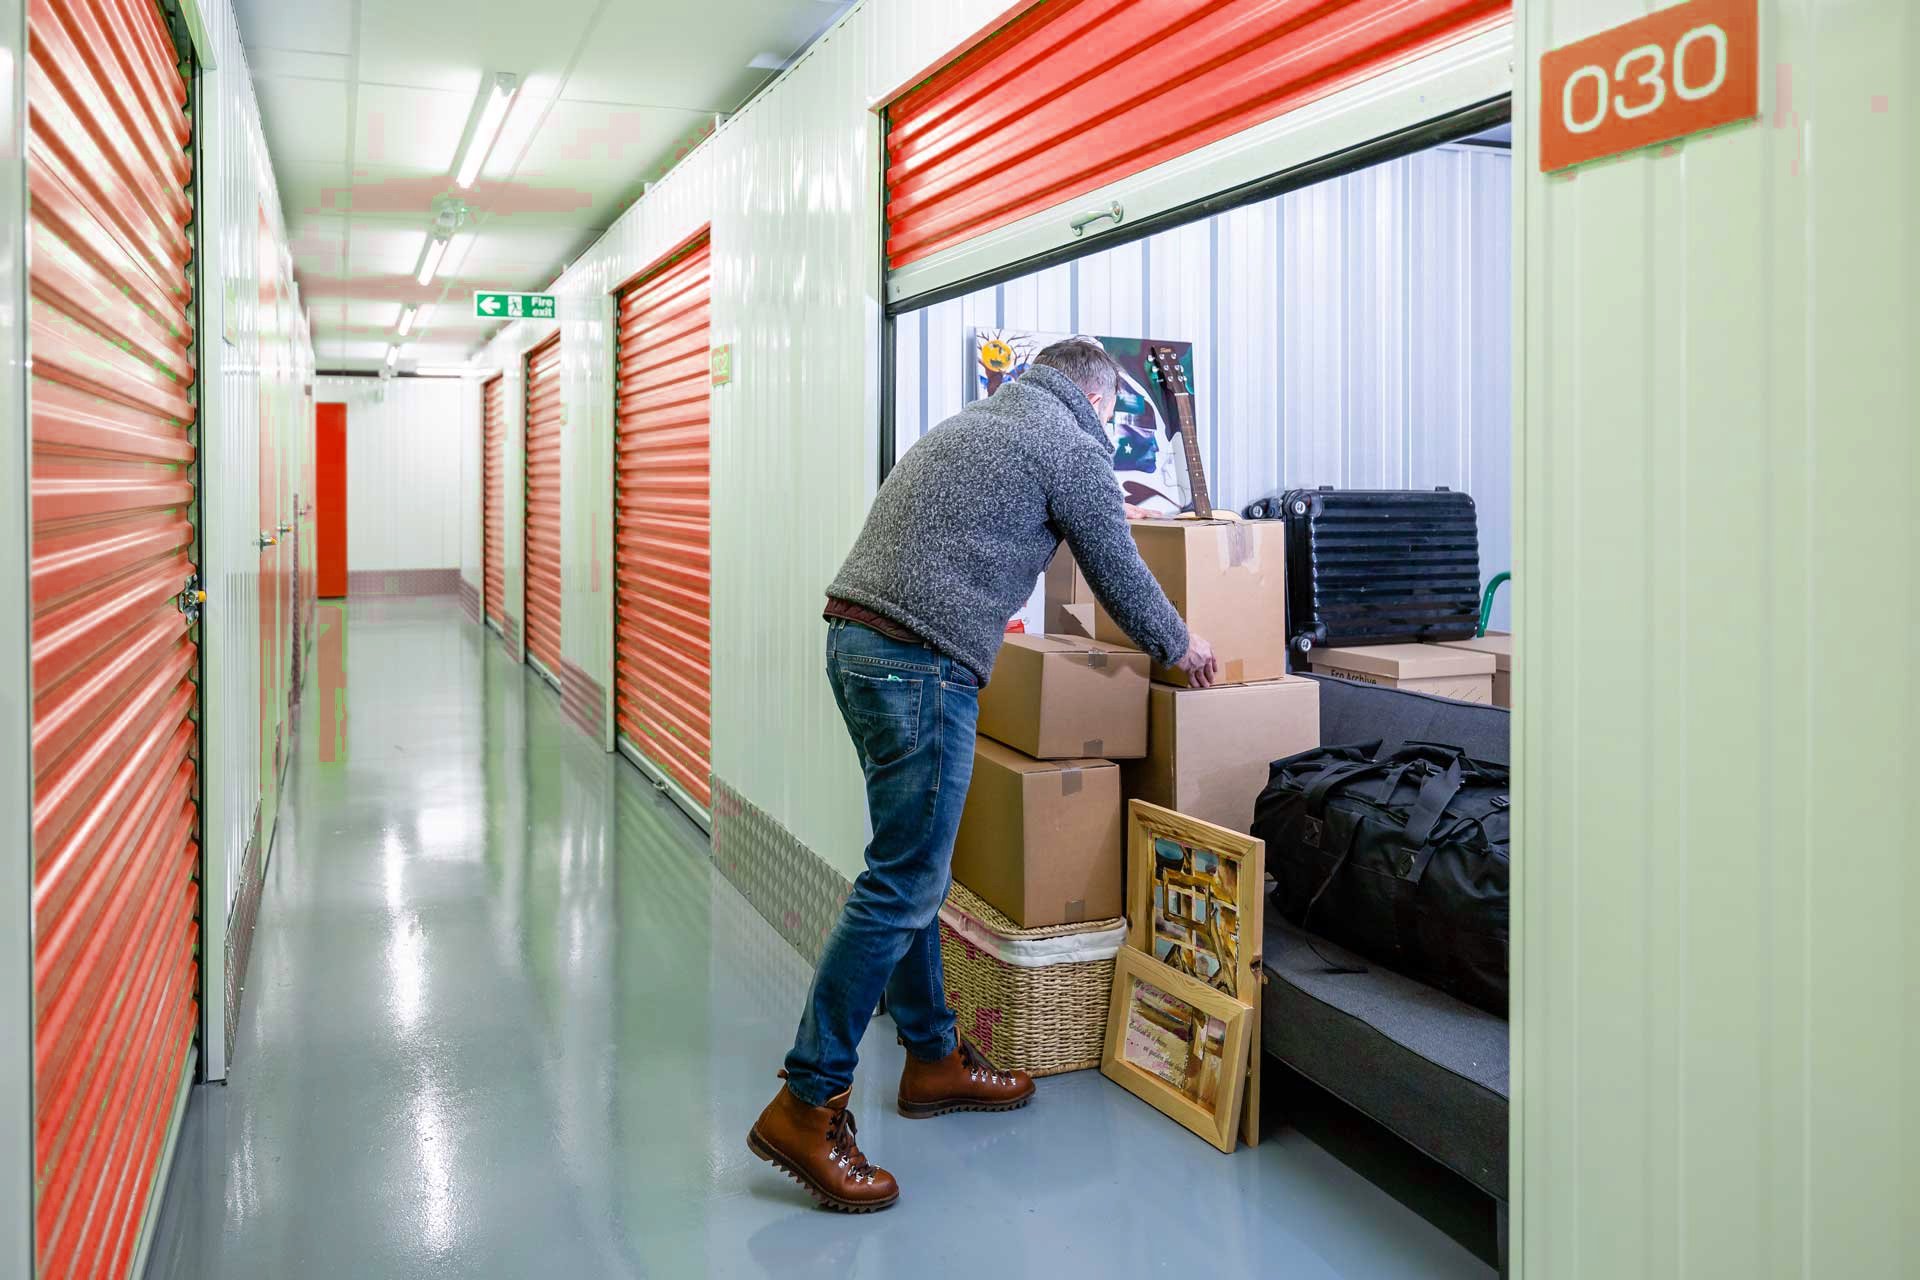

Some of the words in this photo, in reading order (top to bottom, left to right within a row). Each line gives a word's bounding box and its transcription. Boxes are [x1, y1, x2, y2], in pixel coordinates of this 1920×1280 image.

[1562, 23, 1727, 134] 030
[531, 296, 553, 307] Fire
[531, 307, 553, 317] exit
